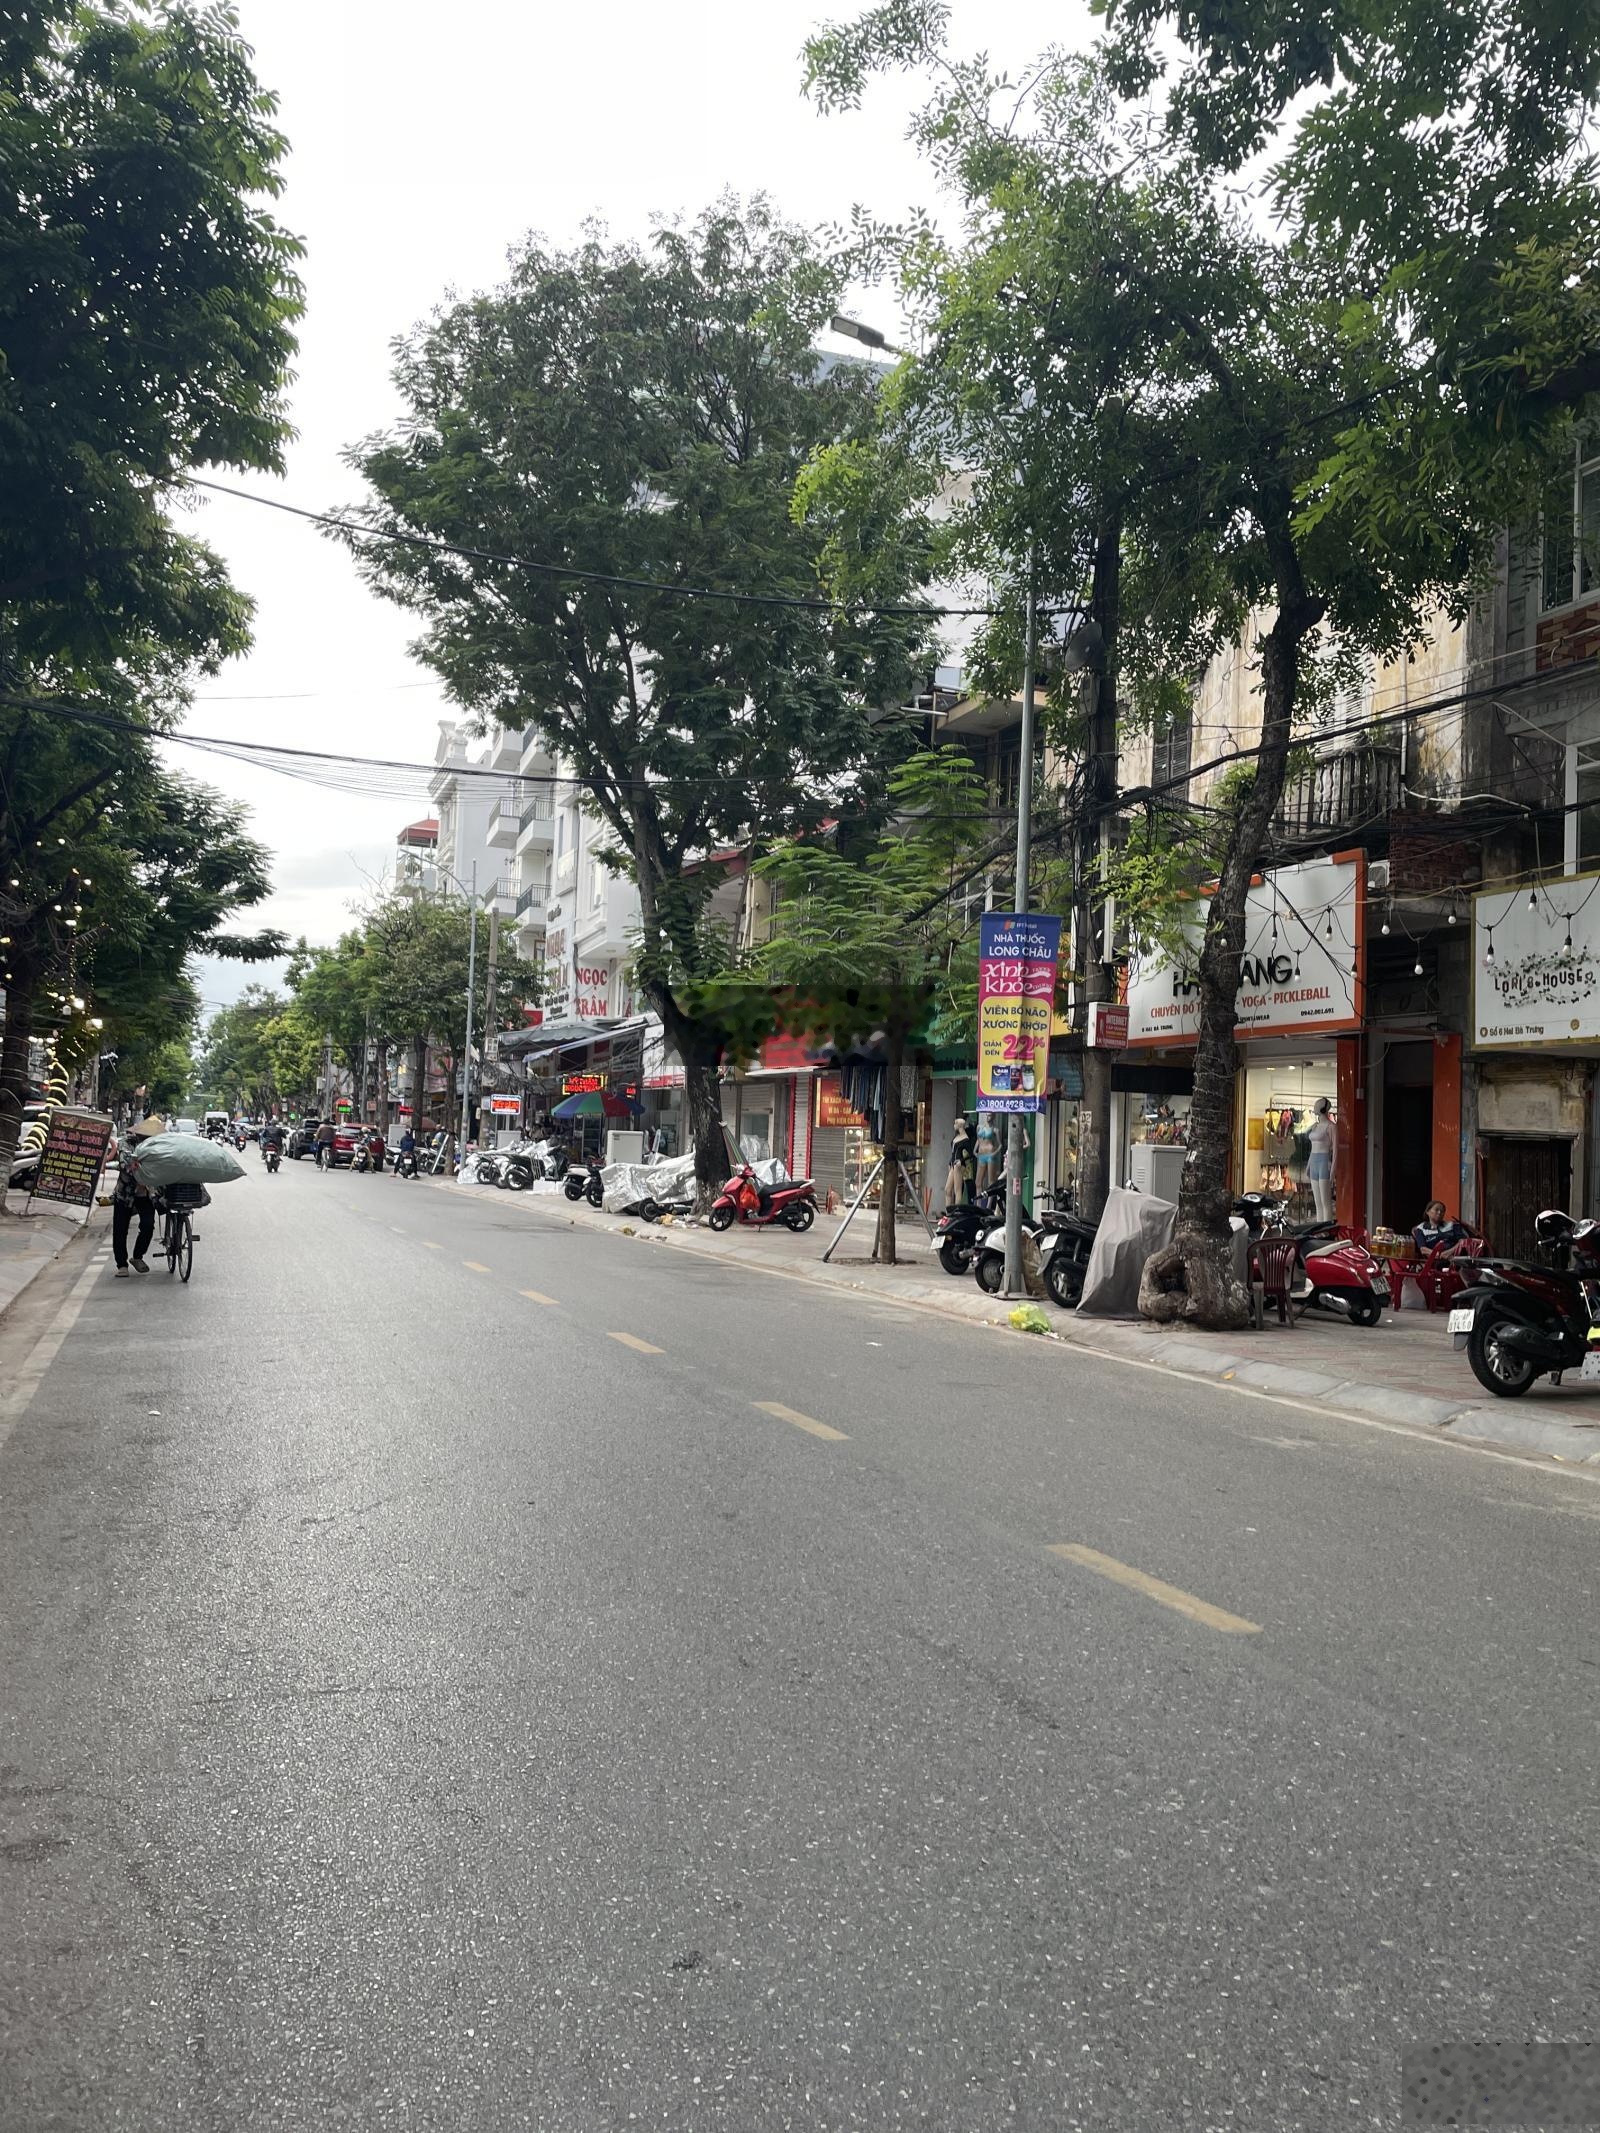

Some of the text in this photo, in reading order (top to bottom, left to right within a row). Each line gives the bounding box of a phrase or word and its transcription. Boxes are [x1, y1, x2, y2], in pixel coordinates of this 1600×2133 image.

[994, 932, 1046, 945] NHÀ THUỐC
[989, 946, 1052, 958] LONG CHÂU
[576, 967, 608, 990] NGỌC
[1543, 969, 1582, 988] HOUSE
[1242, 987, 1330, 1008] YOGA PICKLEBALL
[575, 995, 607, 1017] TRÂM
[984, 1005, 1009, 1015] VIÊN
[1025, 1006, 1047, 1018] NÃO
[1151, 1003, 1180, 1018] CHUYÊN
[983, 1020, 1048, 1031] XƯƠNG KHỚP
[1003, 1033, 1046, 1061] 22%
[987, 1100, 1004, 1108] 1800
[1006, 1100, 1024, 1108] 6928
